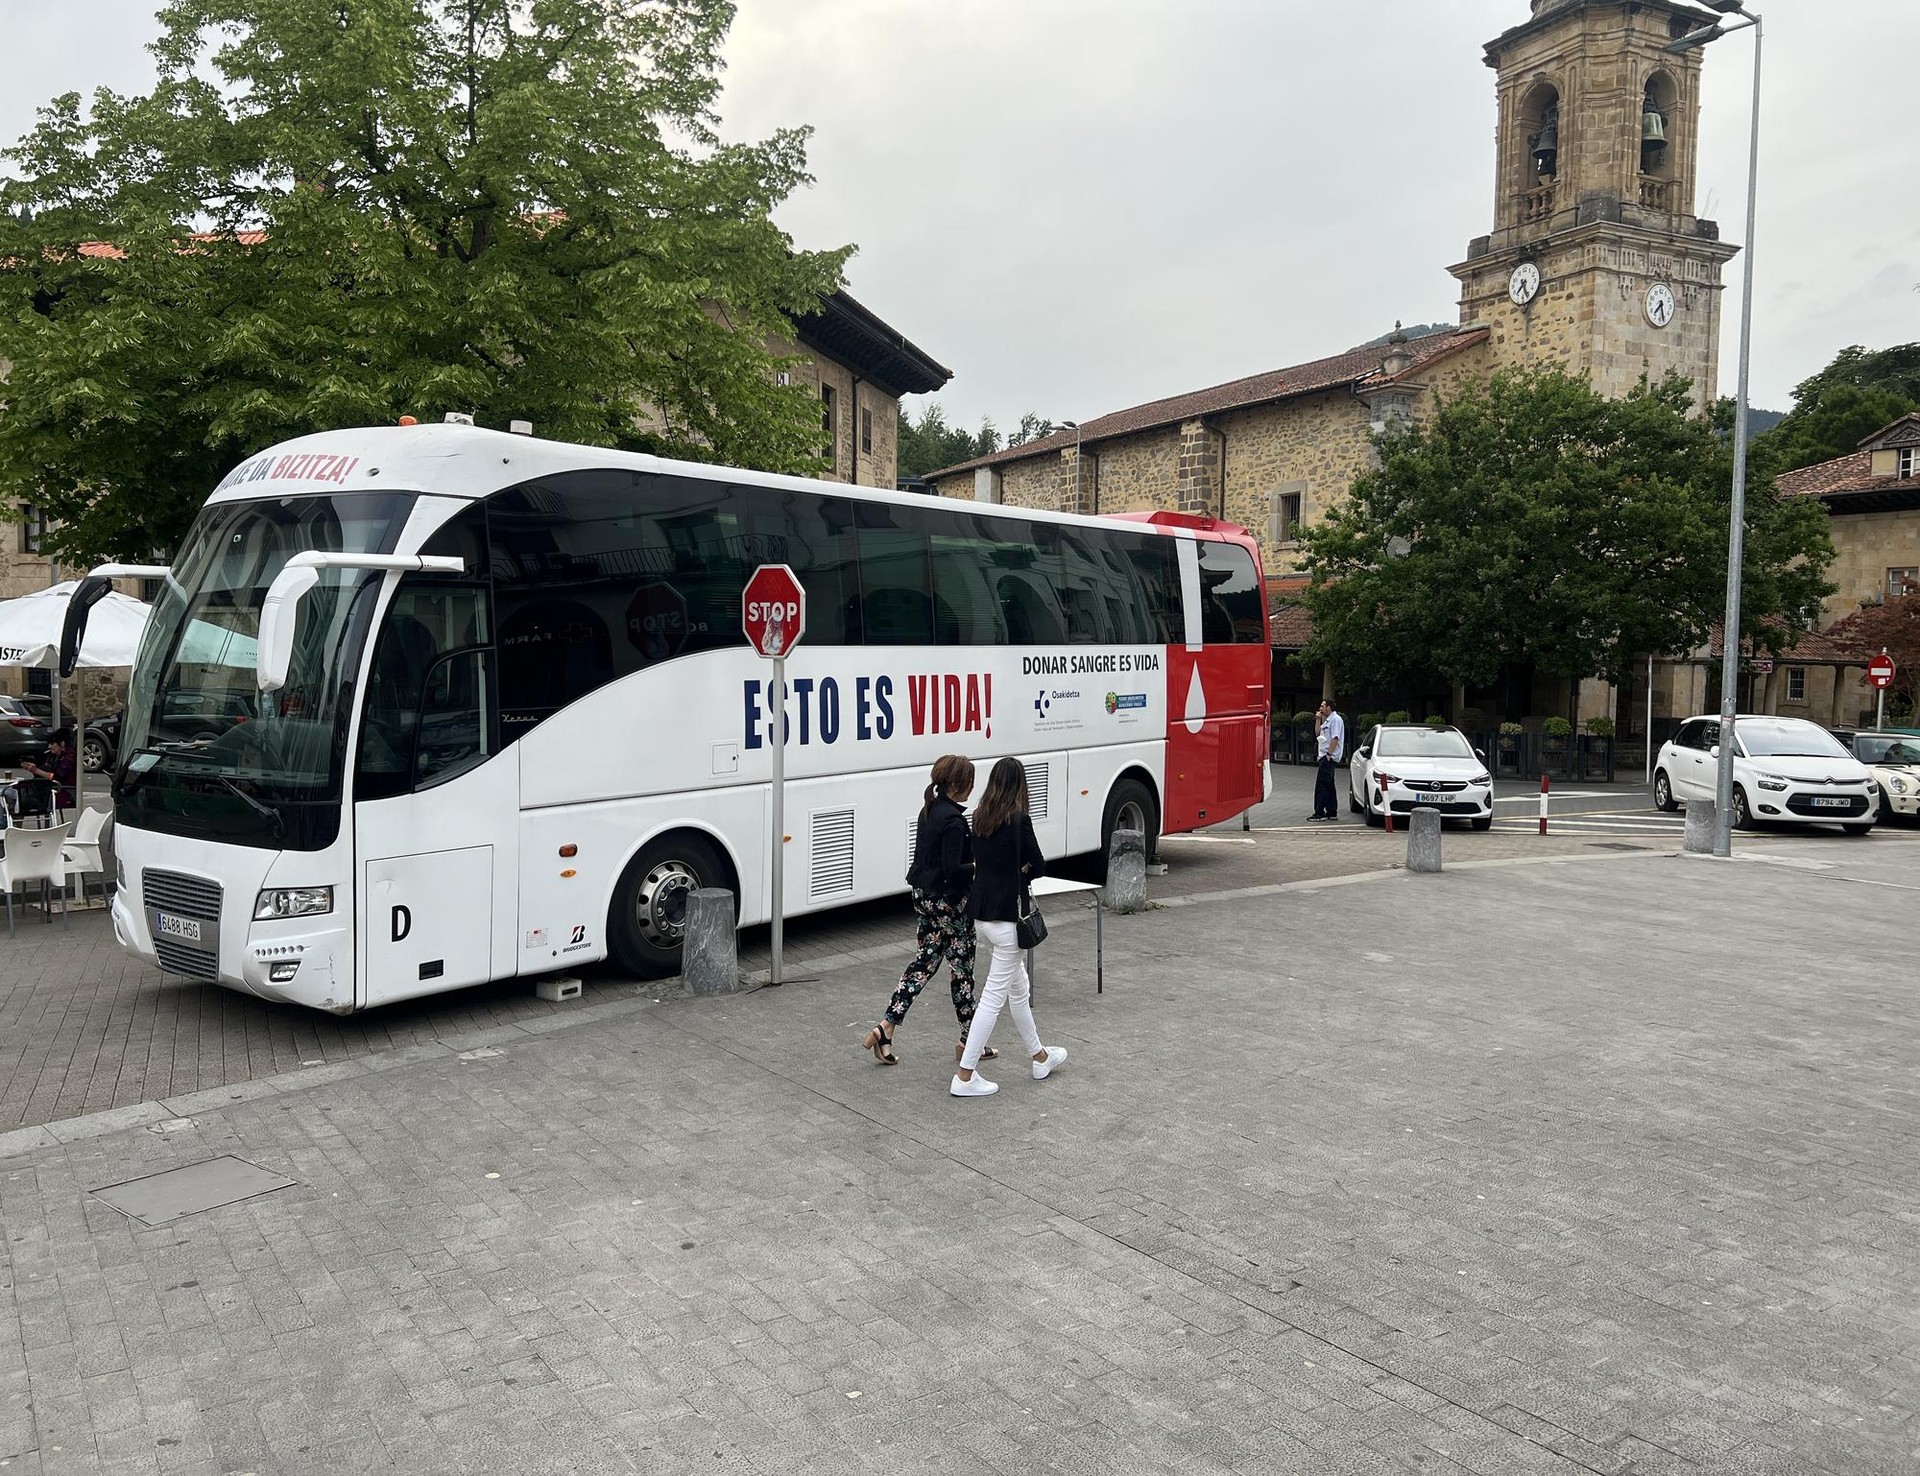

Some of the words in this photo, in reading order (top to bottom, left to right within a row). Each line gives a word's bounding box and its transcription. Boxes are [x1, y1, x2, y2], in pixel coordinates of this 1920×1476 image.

[247, 456, 277, 483] DA
[270, 453, 360, 485] BIZITZA!
[748, 601, 798, 622] STOP
[1022, 656, 1067, 675] DONAR
[1071, 655, 1116, 674] SANGRE
[1119, 654, 1132, 671] ES
[1134, 654, 1159, 671] VIDA
[1051, 690, 1080, 700] Osakidetza
[743, 676, 840, 750] ESTO
[856, 675, 894, 741] ES
[908, 673, 992, 740] VIDA!
[162, 915, 180, 934] 6488
[183, 920, 198, 938] HSG
[391, 904, 411, 942] D
